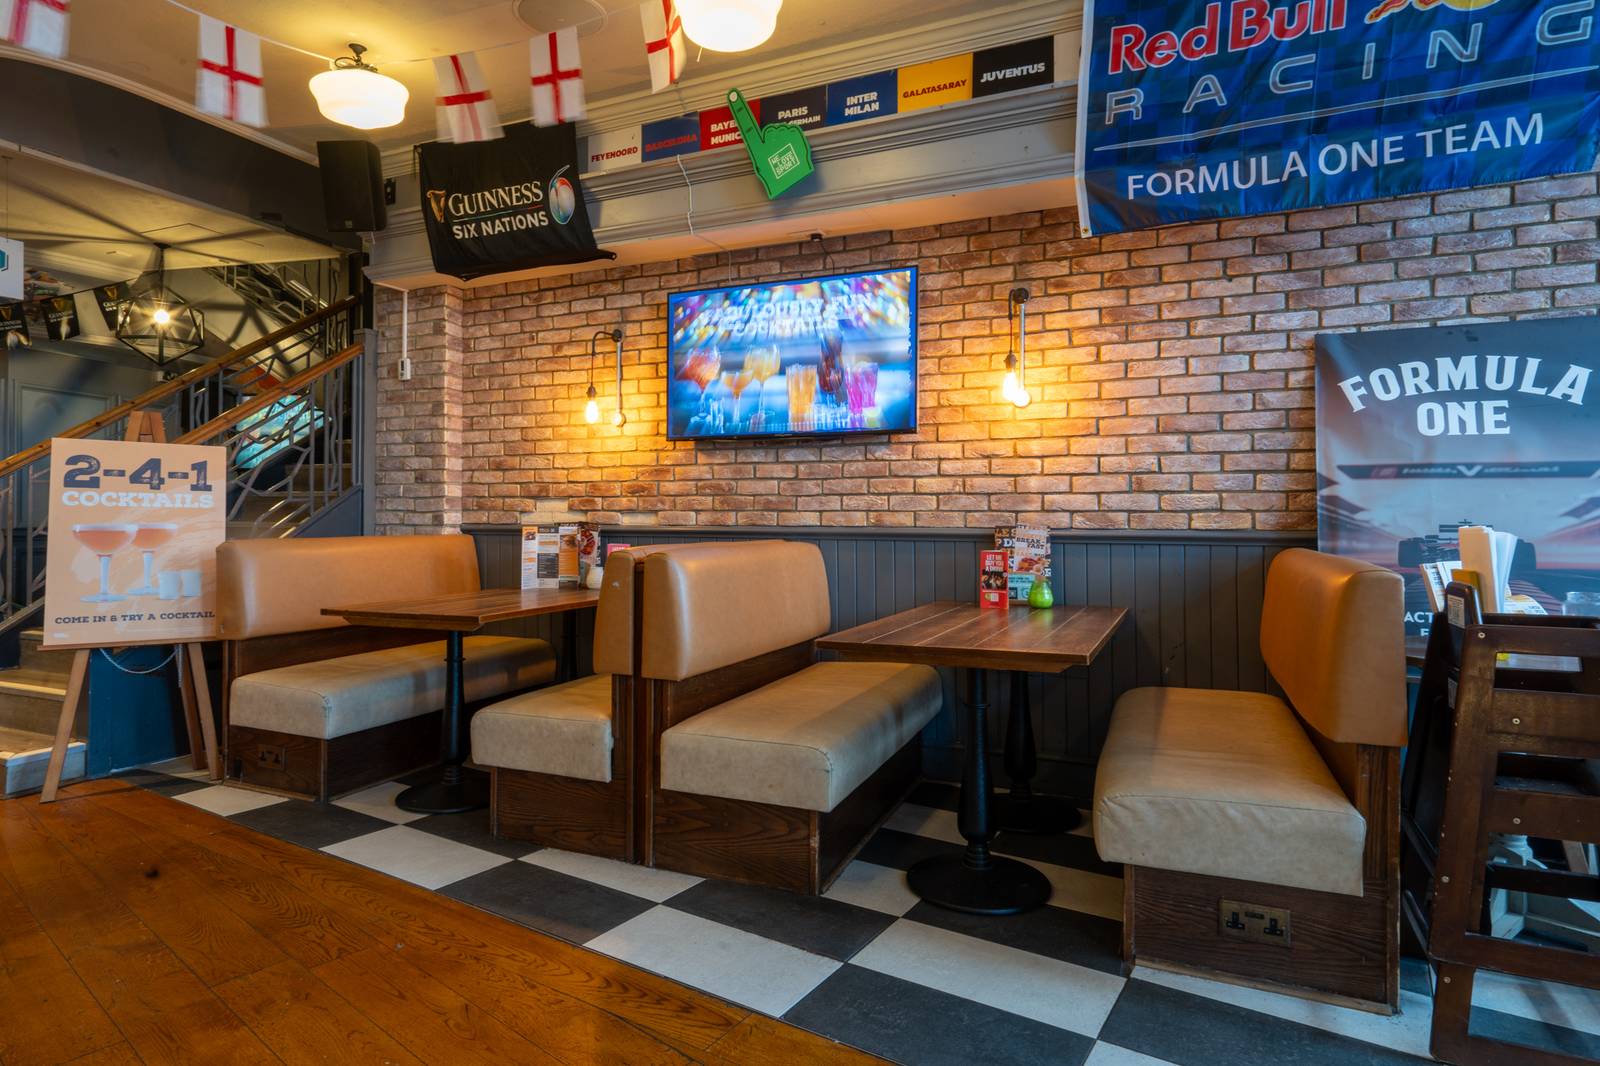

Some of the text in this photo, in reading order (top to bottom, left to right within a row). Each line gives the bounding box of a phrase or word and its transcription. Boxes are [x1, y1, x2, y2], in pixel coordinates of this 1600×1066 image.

[1108, 0, 1347, 75] Red Bull
[980, 62, 1046, 83] JUVENTUS
[1105, 1, 1594, 125] RACING
[902, 79, 967, 98] GALATASARAY
[846, 91, 878, 106] INTER
[778, 106, 808, 120] PARIS
[844, 102, 880, 116] MILAN
[710, 120, 738, 132] BAYE
[710, 131, 742, 145] MUNIC
[591, 146, 639, 163] FEYENOORD
[1127, 113, 1543, 200] FORMULA ONE TEAM
[448, 181, 543, 217] GUINNESS
[452, 211, 549, 240] SIX NATIONS
[1338, 355, 1592, 413] FORMULA
[1416, 400, 1511, 436] ONE
[63, 454, 213, 492] 2-4-1
[62, 491, 215, 509] COCKTAILS
[55, 616, 89, 624] COME
[93, 615, 107, 623] IN
[121, 613, 143, 622] TRY
[147, 613, 156, 621] A
[160, 611, 216, 621] COCKTAIL
[1403, 611, 1434, 623] ACT
